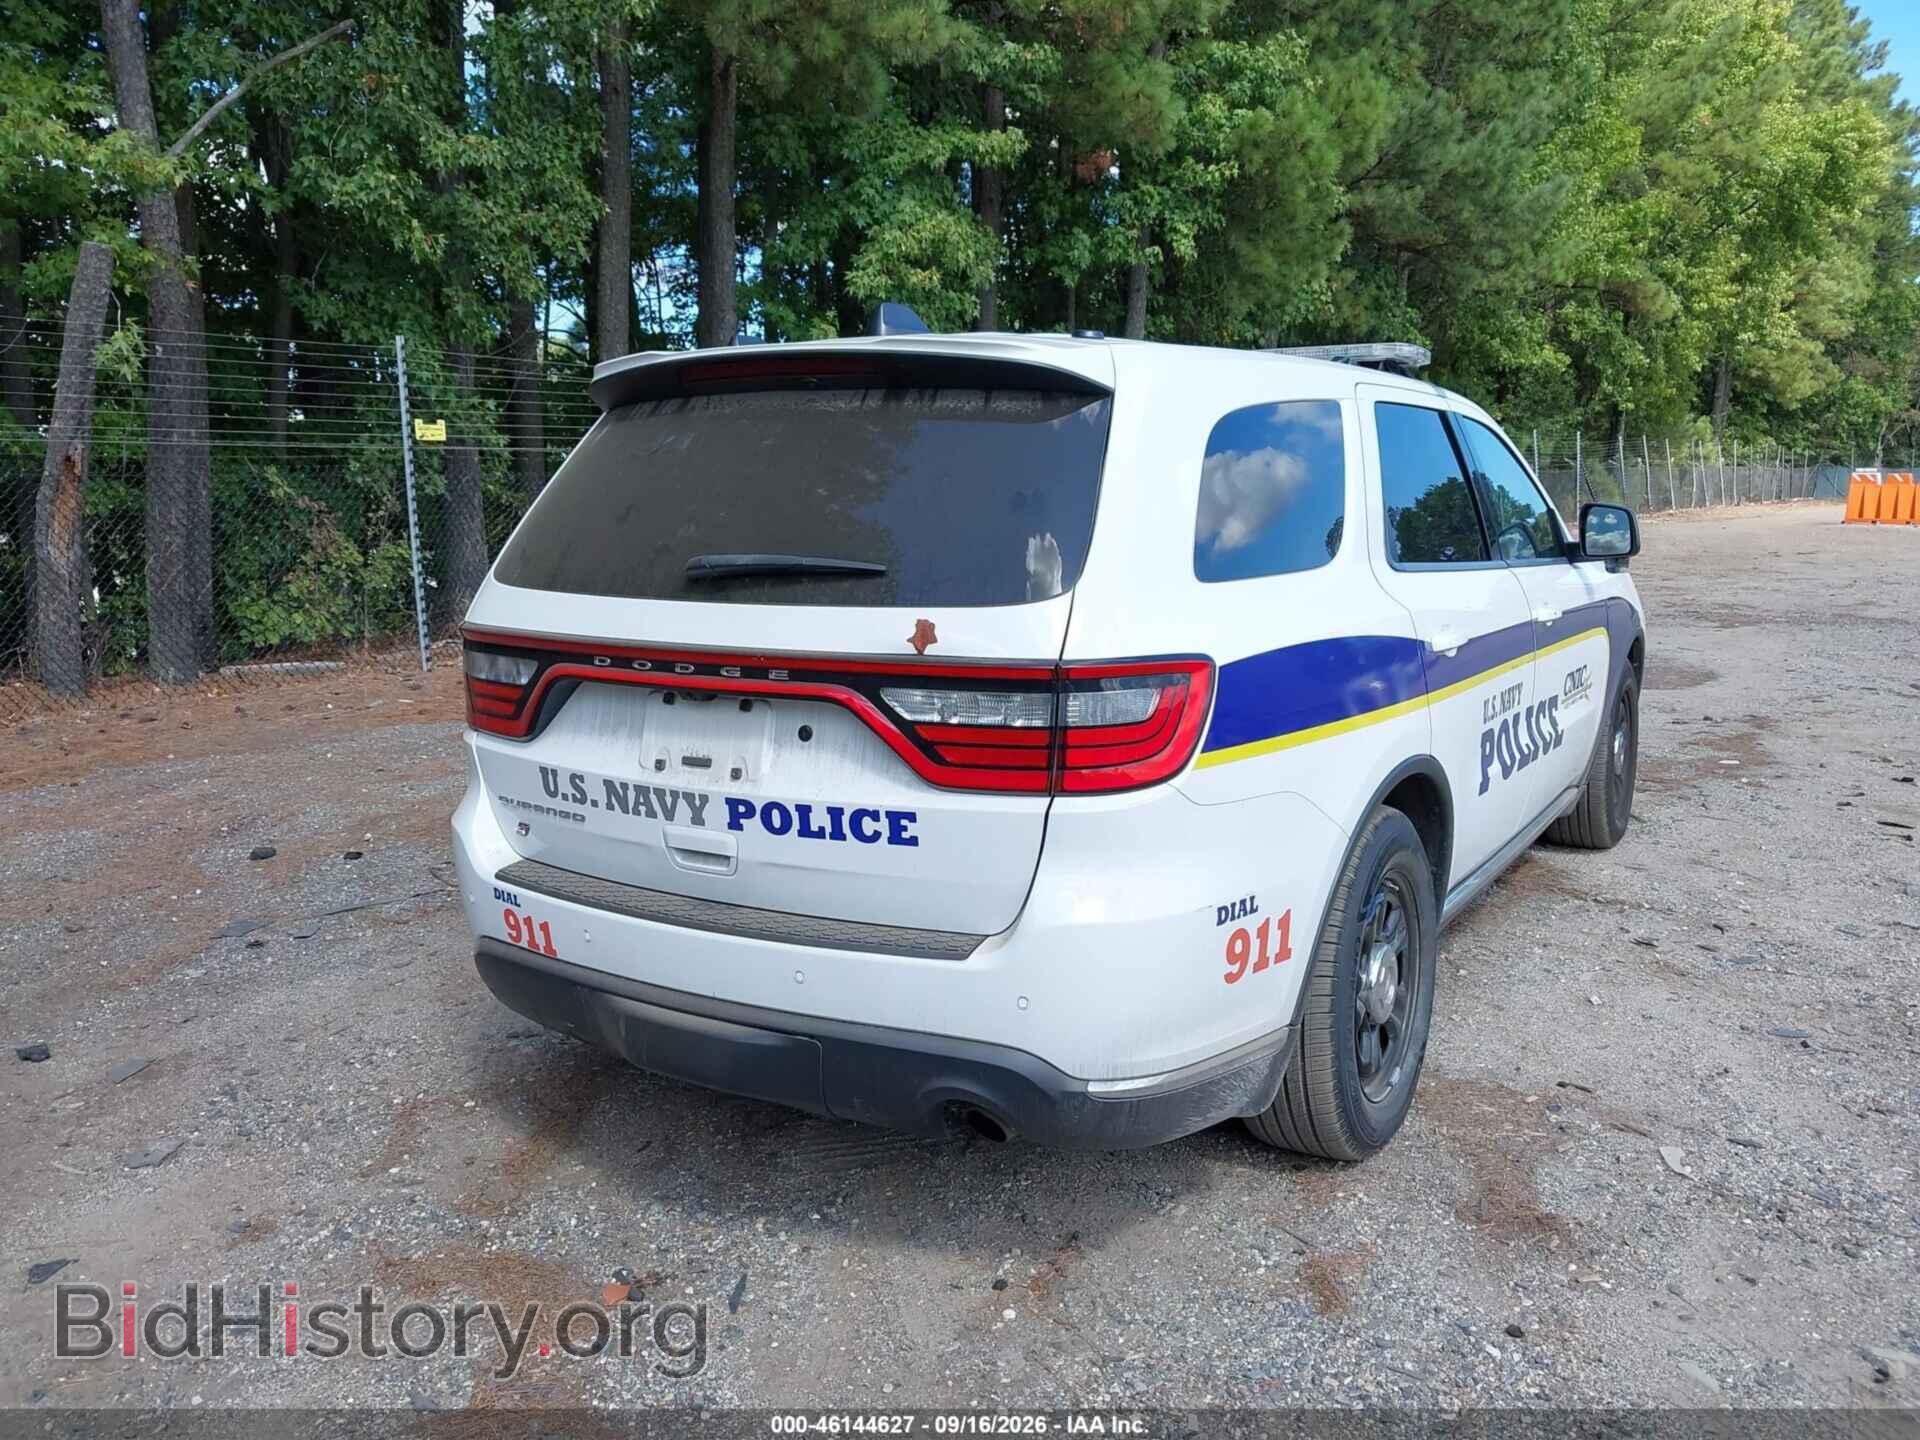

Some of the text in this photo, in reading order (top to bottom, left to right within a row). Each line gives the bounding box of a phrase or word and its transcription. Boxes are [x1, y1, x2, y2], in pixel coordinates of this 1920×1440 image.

[593, 655, 790, 681] DODGE
[1563, 664, 1588, 697] CNIC
[1483, 694, 1498, 725] U.S.
[1499, 680, 1523, 716] NAVY
[1478, 694, 1564, 797] POLICE
[498, 795, 587, 823] DURANGO
[538, 766, 710, 827] U.S. NAVY
[724, 796, 920, 848] POLICE
[493, 887, 521, 908] DIAL
[1216, 895, 1259, 927] DIAL
[503, 908, 558, 958] 911
[1223, 908, 1292, 985] 911
